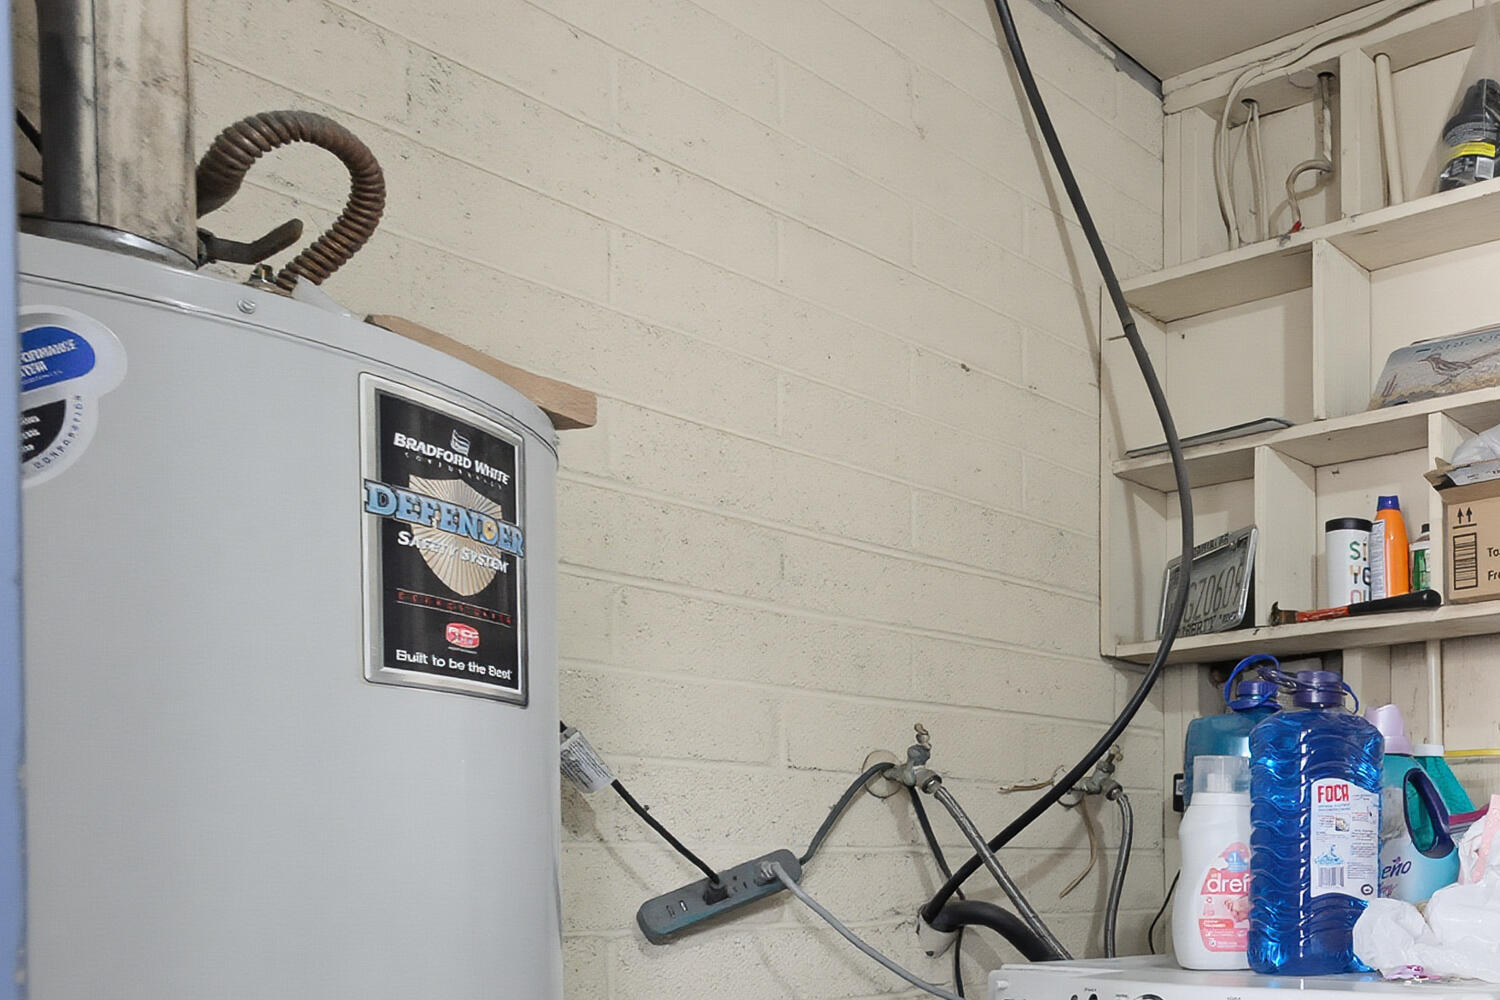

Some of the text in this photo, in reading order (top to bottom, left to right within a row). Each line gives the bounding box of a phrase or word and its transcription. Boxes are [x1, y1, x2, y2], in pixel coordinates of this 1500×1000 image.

[392, 432, 511, 485] BRADFORD WHITE
[363, 478, 525, 559] DEFENDER
[397, 530, 510, 574] SAFETY SYSTEM
[395, 648, 513, 681] Built to be the Best
[1317, 783, 1350, 803] FOCA
